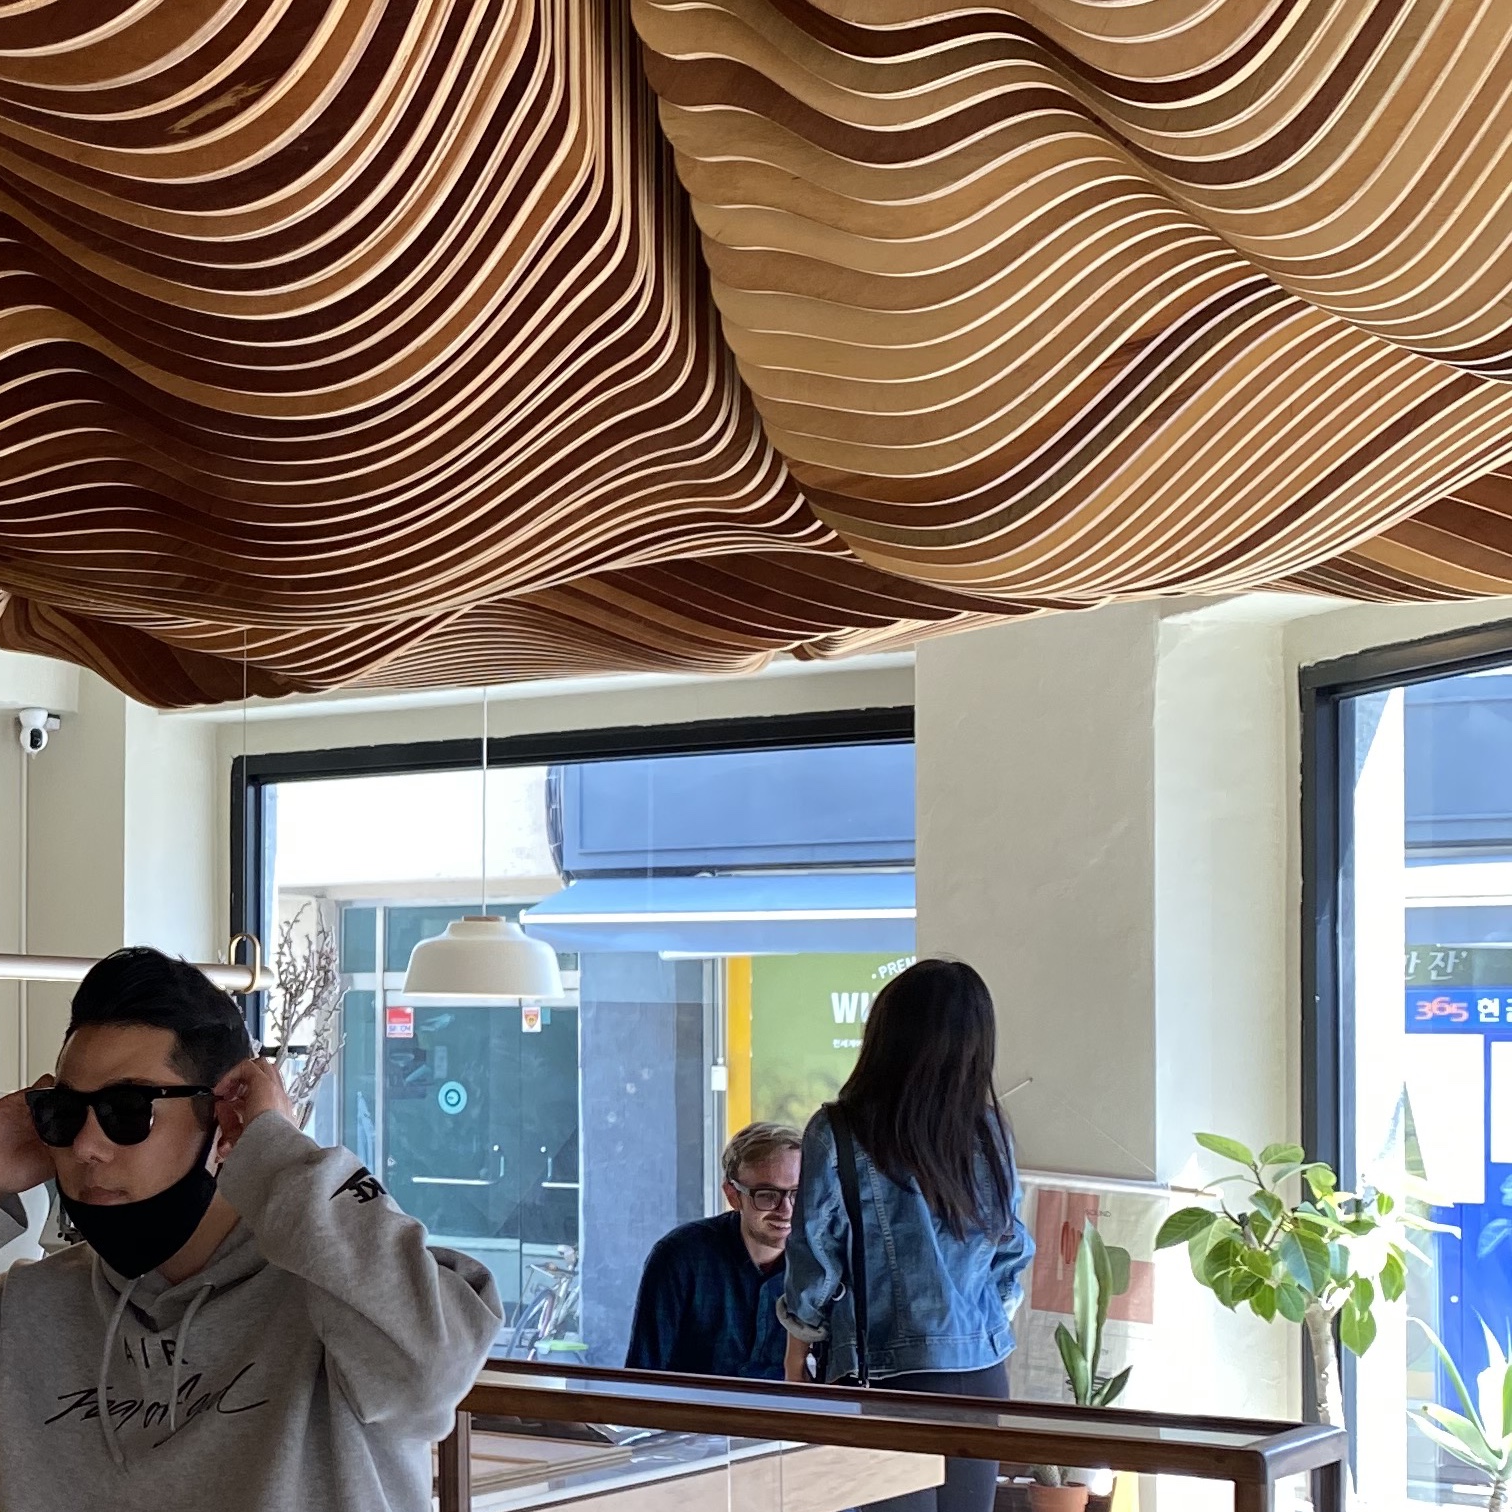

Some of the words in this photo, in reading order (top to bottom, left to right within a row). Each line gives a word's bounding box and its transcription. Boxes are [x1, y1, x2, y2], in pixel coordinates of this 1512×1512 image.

[1414, 996, 1469, 1022] 365
[1477, 998, 1512, 1022] 현
[124, 1337, 189, 1369] AIR
